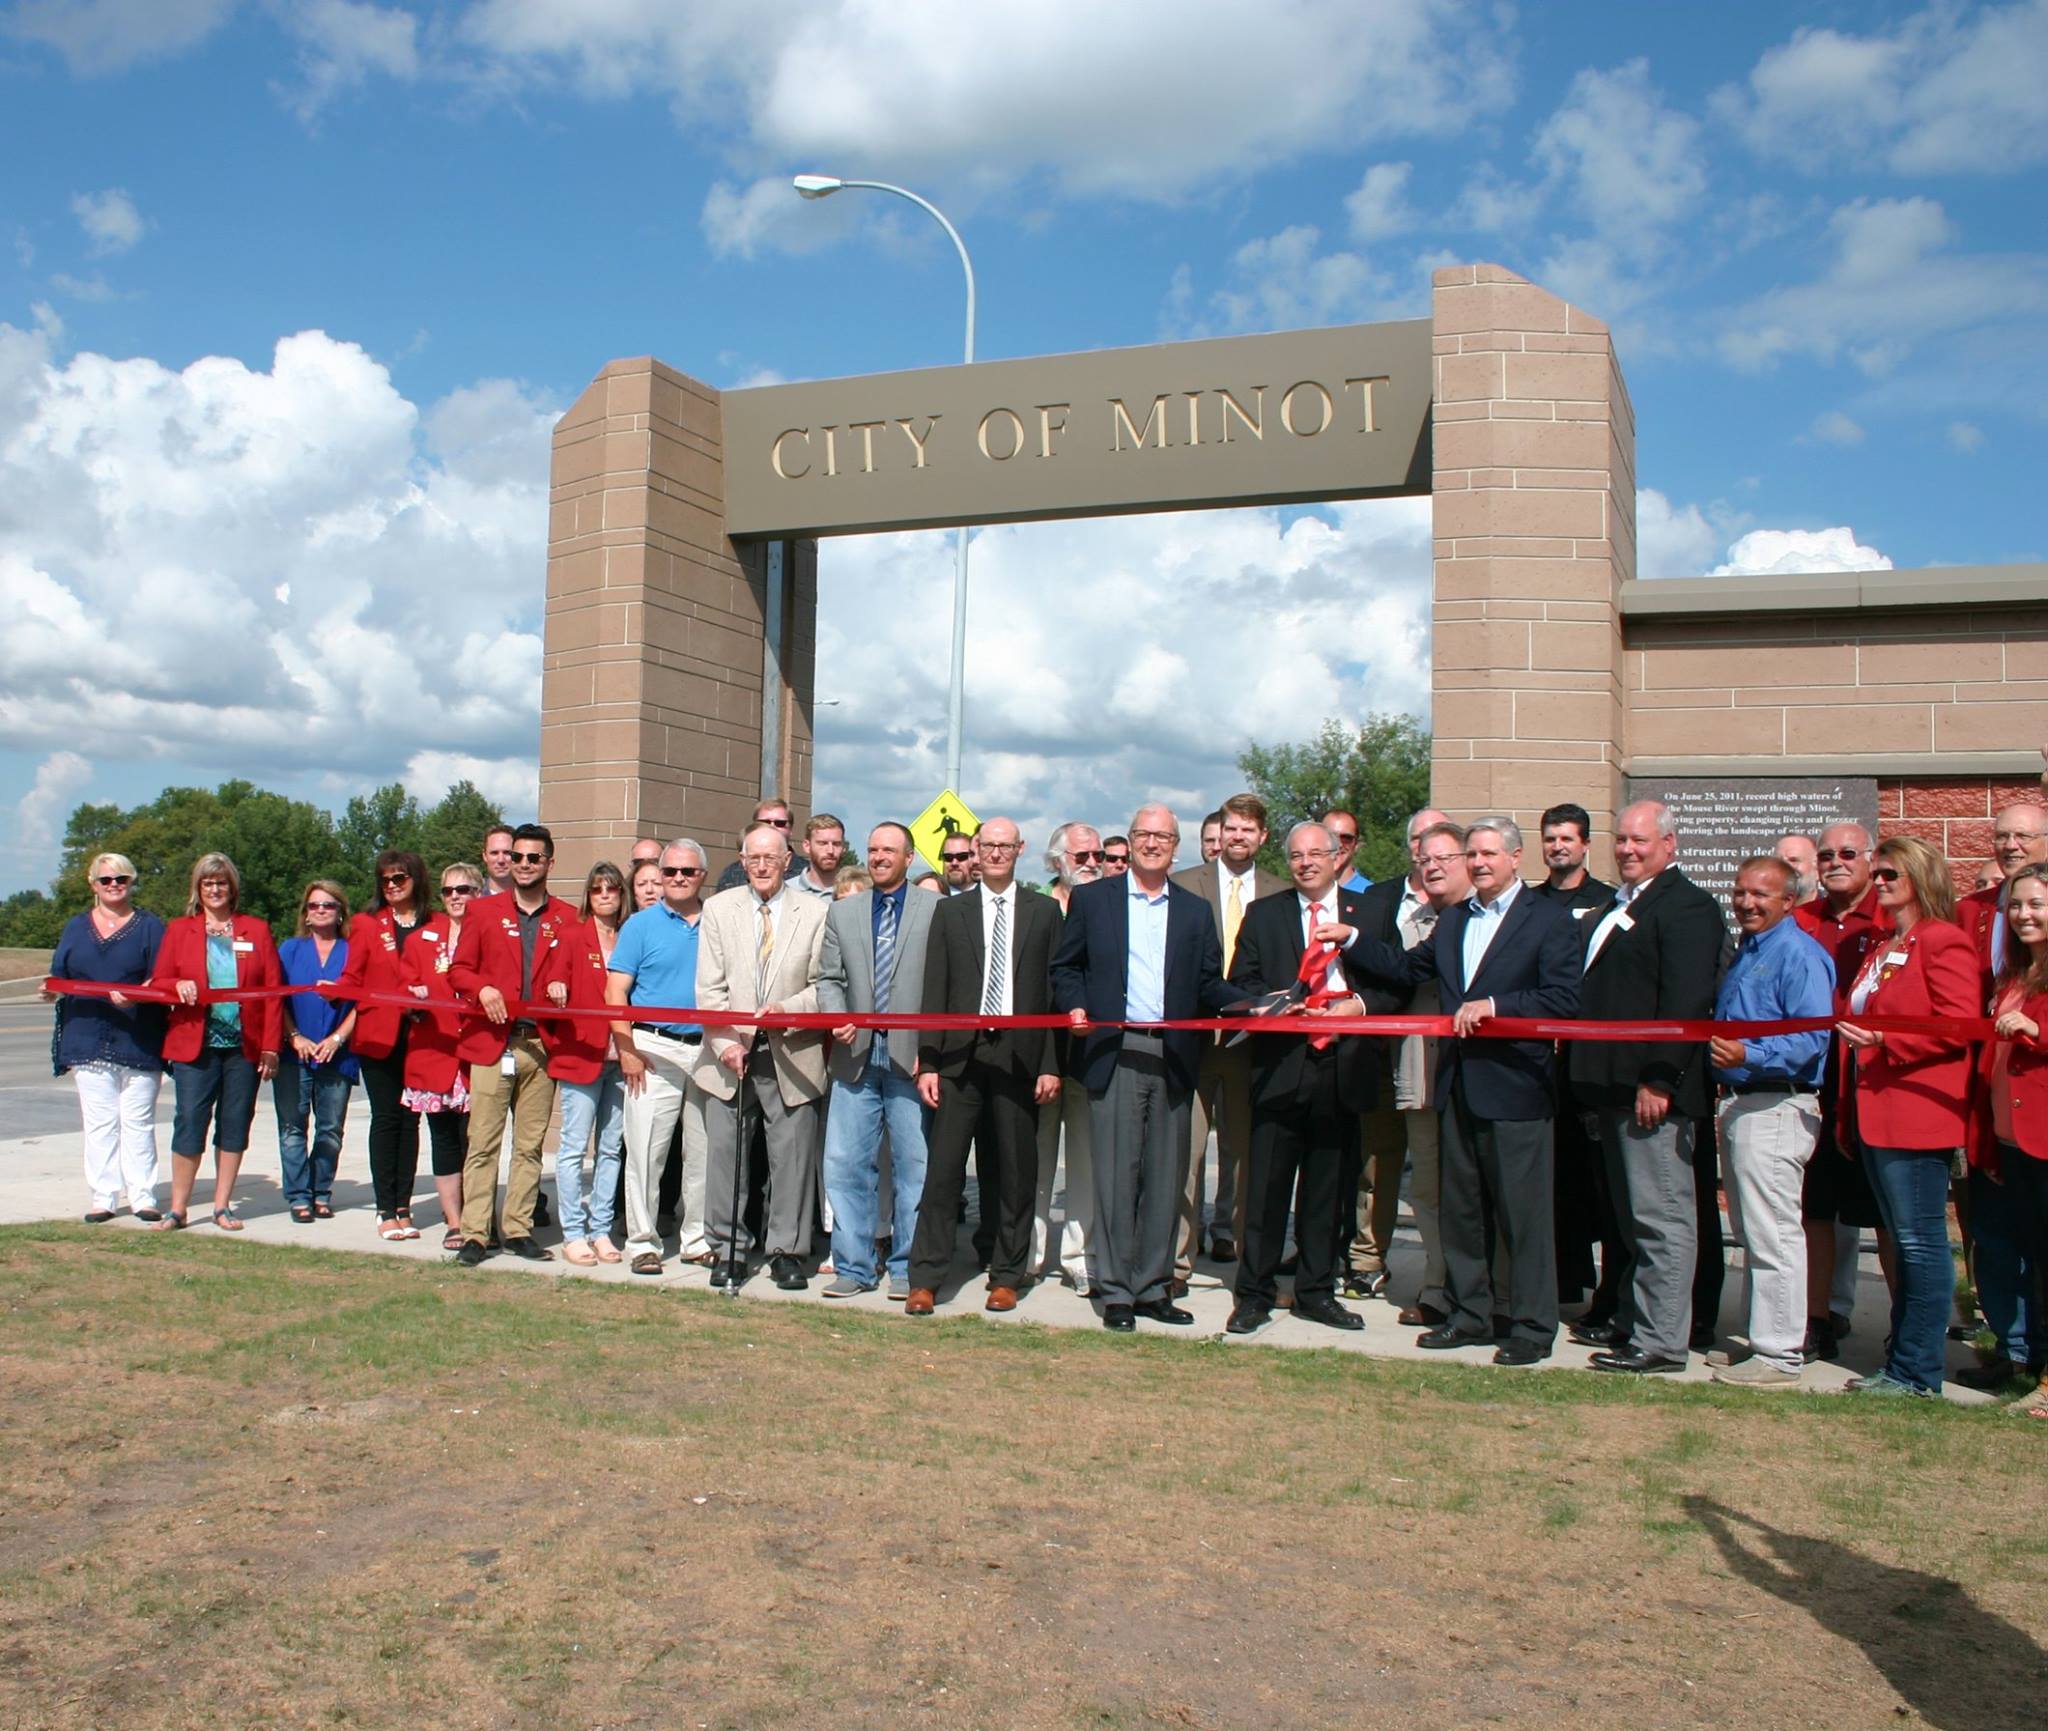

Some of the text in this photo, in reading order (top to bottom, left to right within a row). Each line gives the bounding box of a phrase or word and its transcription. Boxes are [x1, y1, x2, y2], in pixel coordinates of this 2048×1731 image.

[771, 375, 1391, 480] CITY OF MINOT
[1664, 792, 1678, 801] On
[1680, 792, 1702, 801] June
[1704, 792, 1718, 801] 25,
[1720, 792, 1744, 801] 2011,
[1745, 792, 1775, 800] record
[1777, 792, 1798, 802] high
[1832, 792, 1843, 801] of
[1683, 804, 1713, 812] Mouse
[1715, 804, 1739, 812] River
[1742, 805, 1767, 814] swept
[1769, 804, 1806, 813] through
[1740, 816, 1781, 825] changing
[1678, 826, 1713, 836] altering
[1714, 826, 1729, 835] the
[1731, 826, 1775, 836] landscape
[1777, 826, 1787, 835] of
[1682, 847, 1738, 857] structure
[1741, 846, 1750, 857] is
[1707, 862, 1721, 872] of
